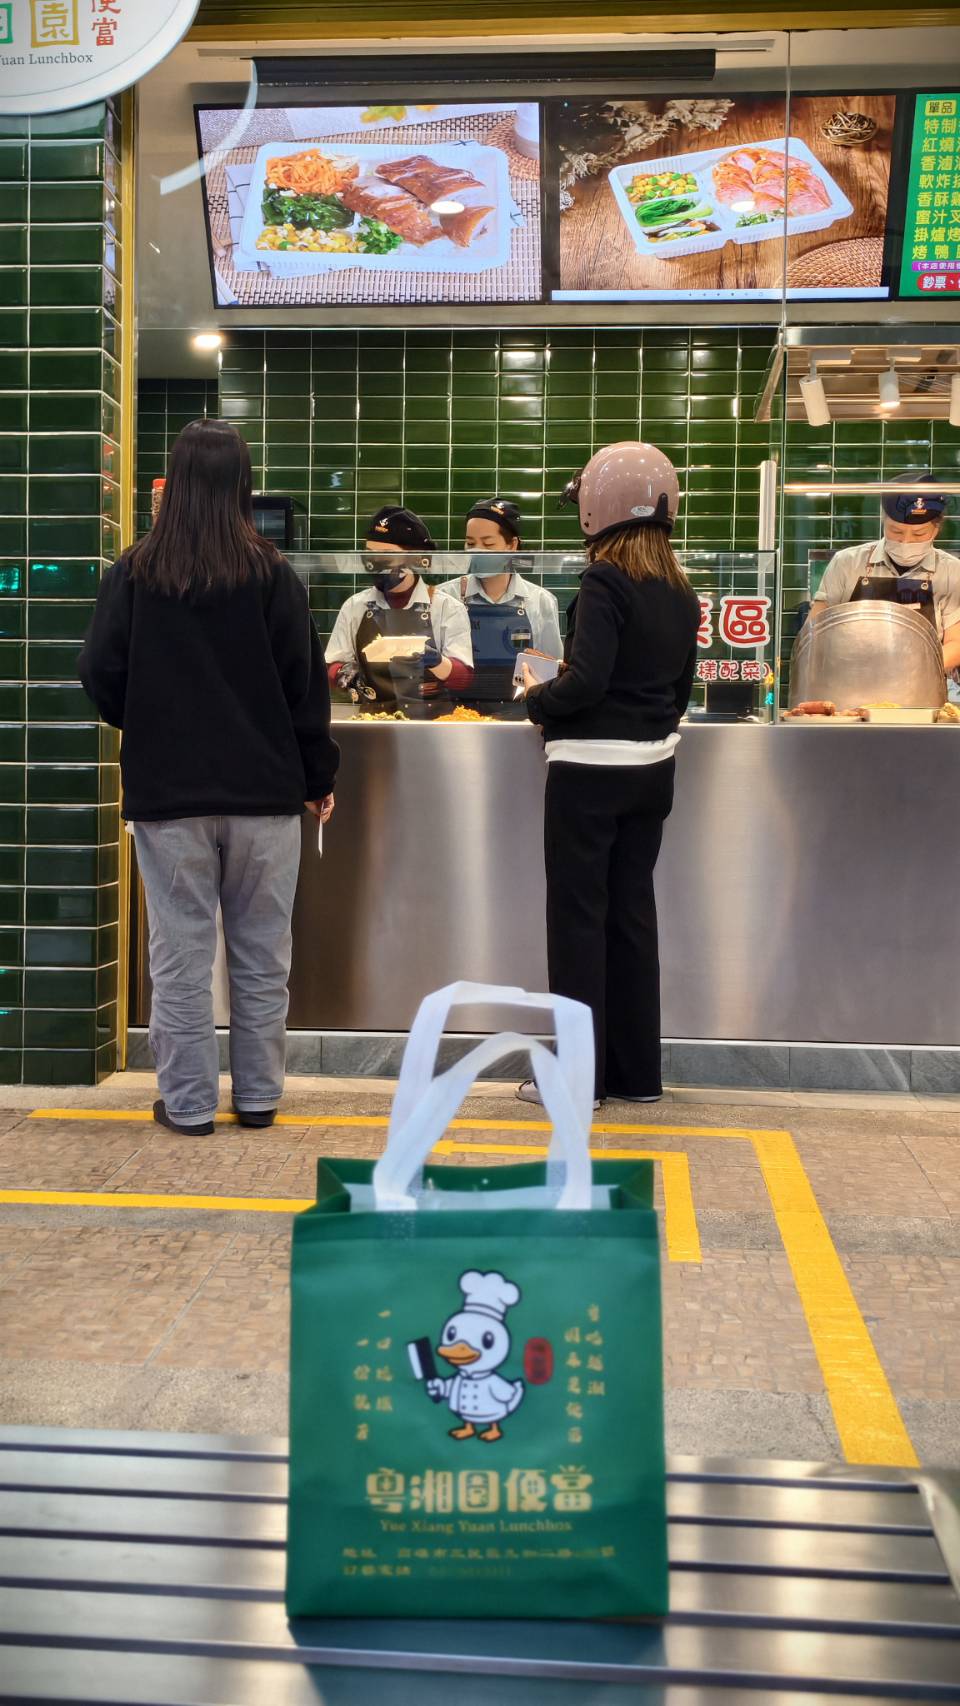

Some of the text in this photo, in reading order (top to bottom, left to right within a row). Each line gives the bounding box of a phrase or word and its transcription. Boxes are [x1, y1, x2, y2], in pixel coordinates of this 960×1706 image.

[29, 52, 94, 65] Lunchbox
[929, 101, 953, 113] 單品
[924, 118, 960, 134] 特制
[912, 245, 960, 260] 烤鴨
[411, 1520, 453, 1534] Xiang
[458, 1520, 495, 1532] Yuan
